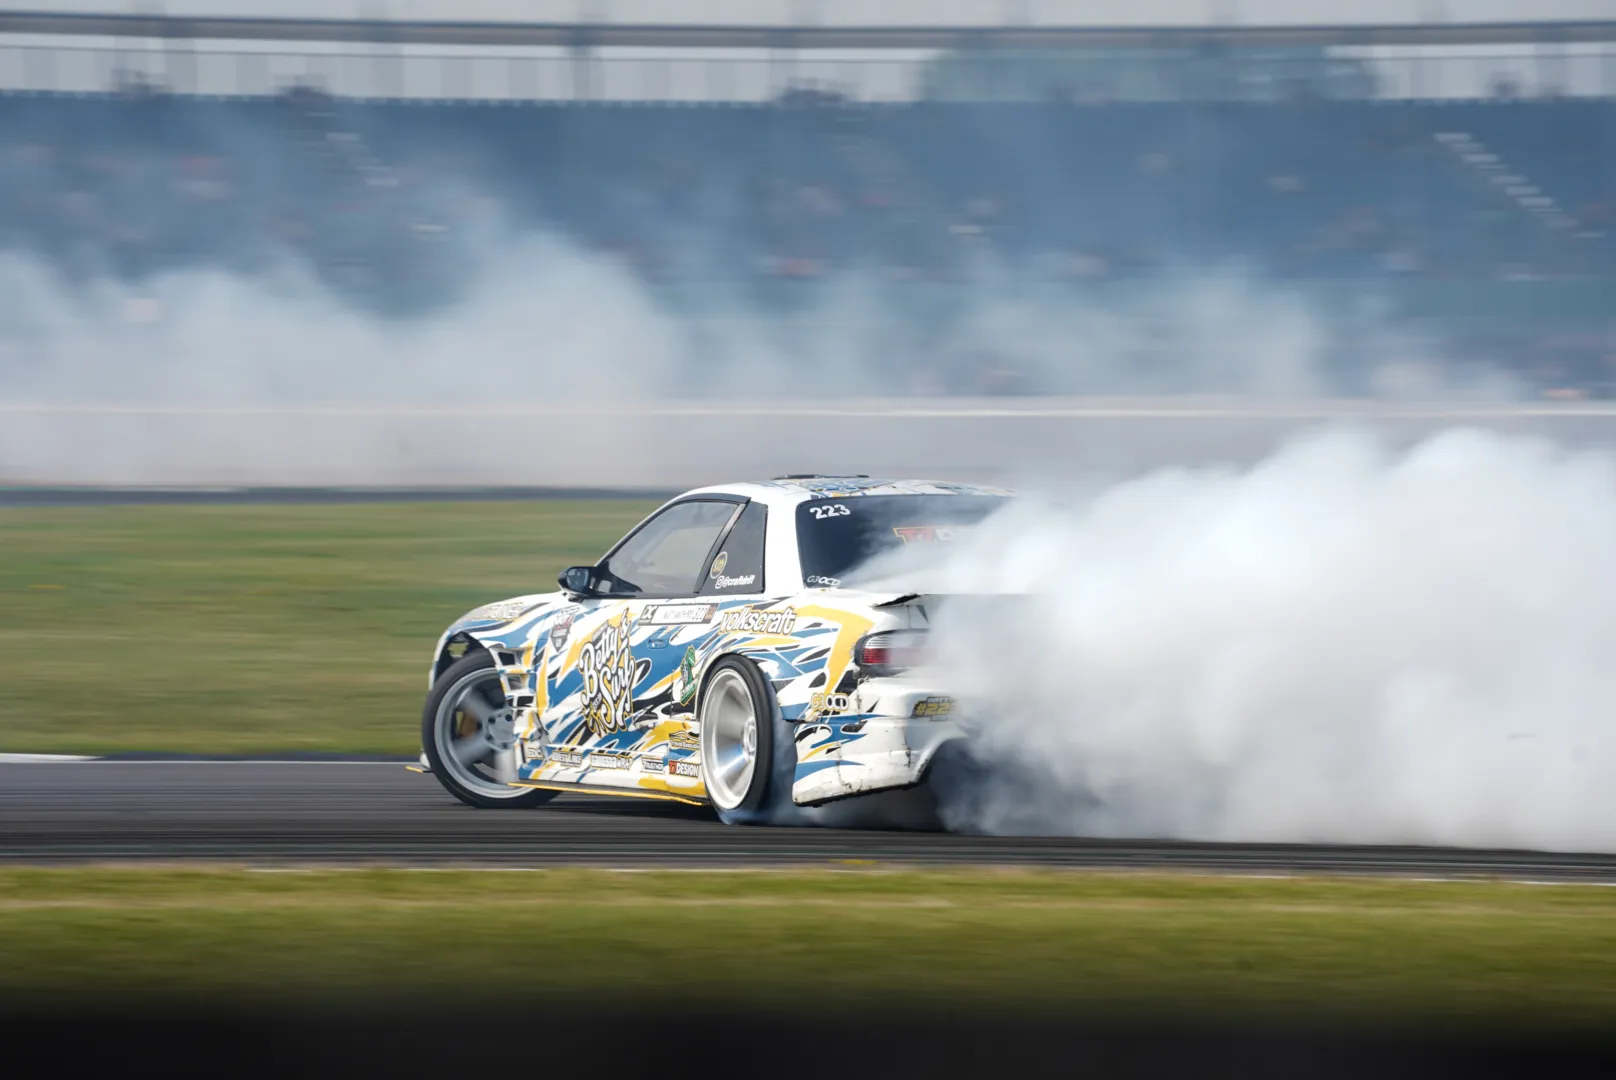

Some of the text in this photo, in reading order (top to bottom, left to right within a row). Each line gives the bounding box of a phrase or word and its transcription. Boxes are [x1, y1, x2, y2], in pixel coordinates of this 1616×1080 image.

[809, 503, 851, 520] 223
[722, 605, 796, 635] volkscraft
[676, 761, 699, 777] DESIGN
